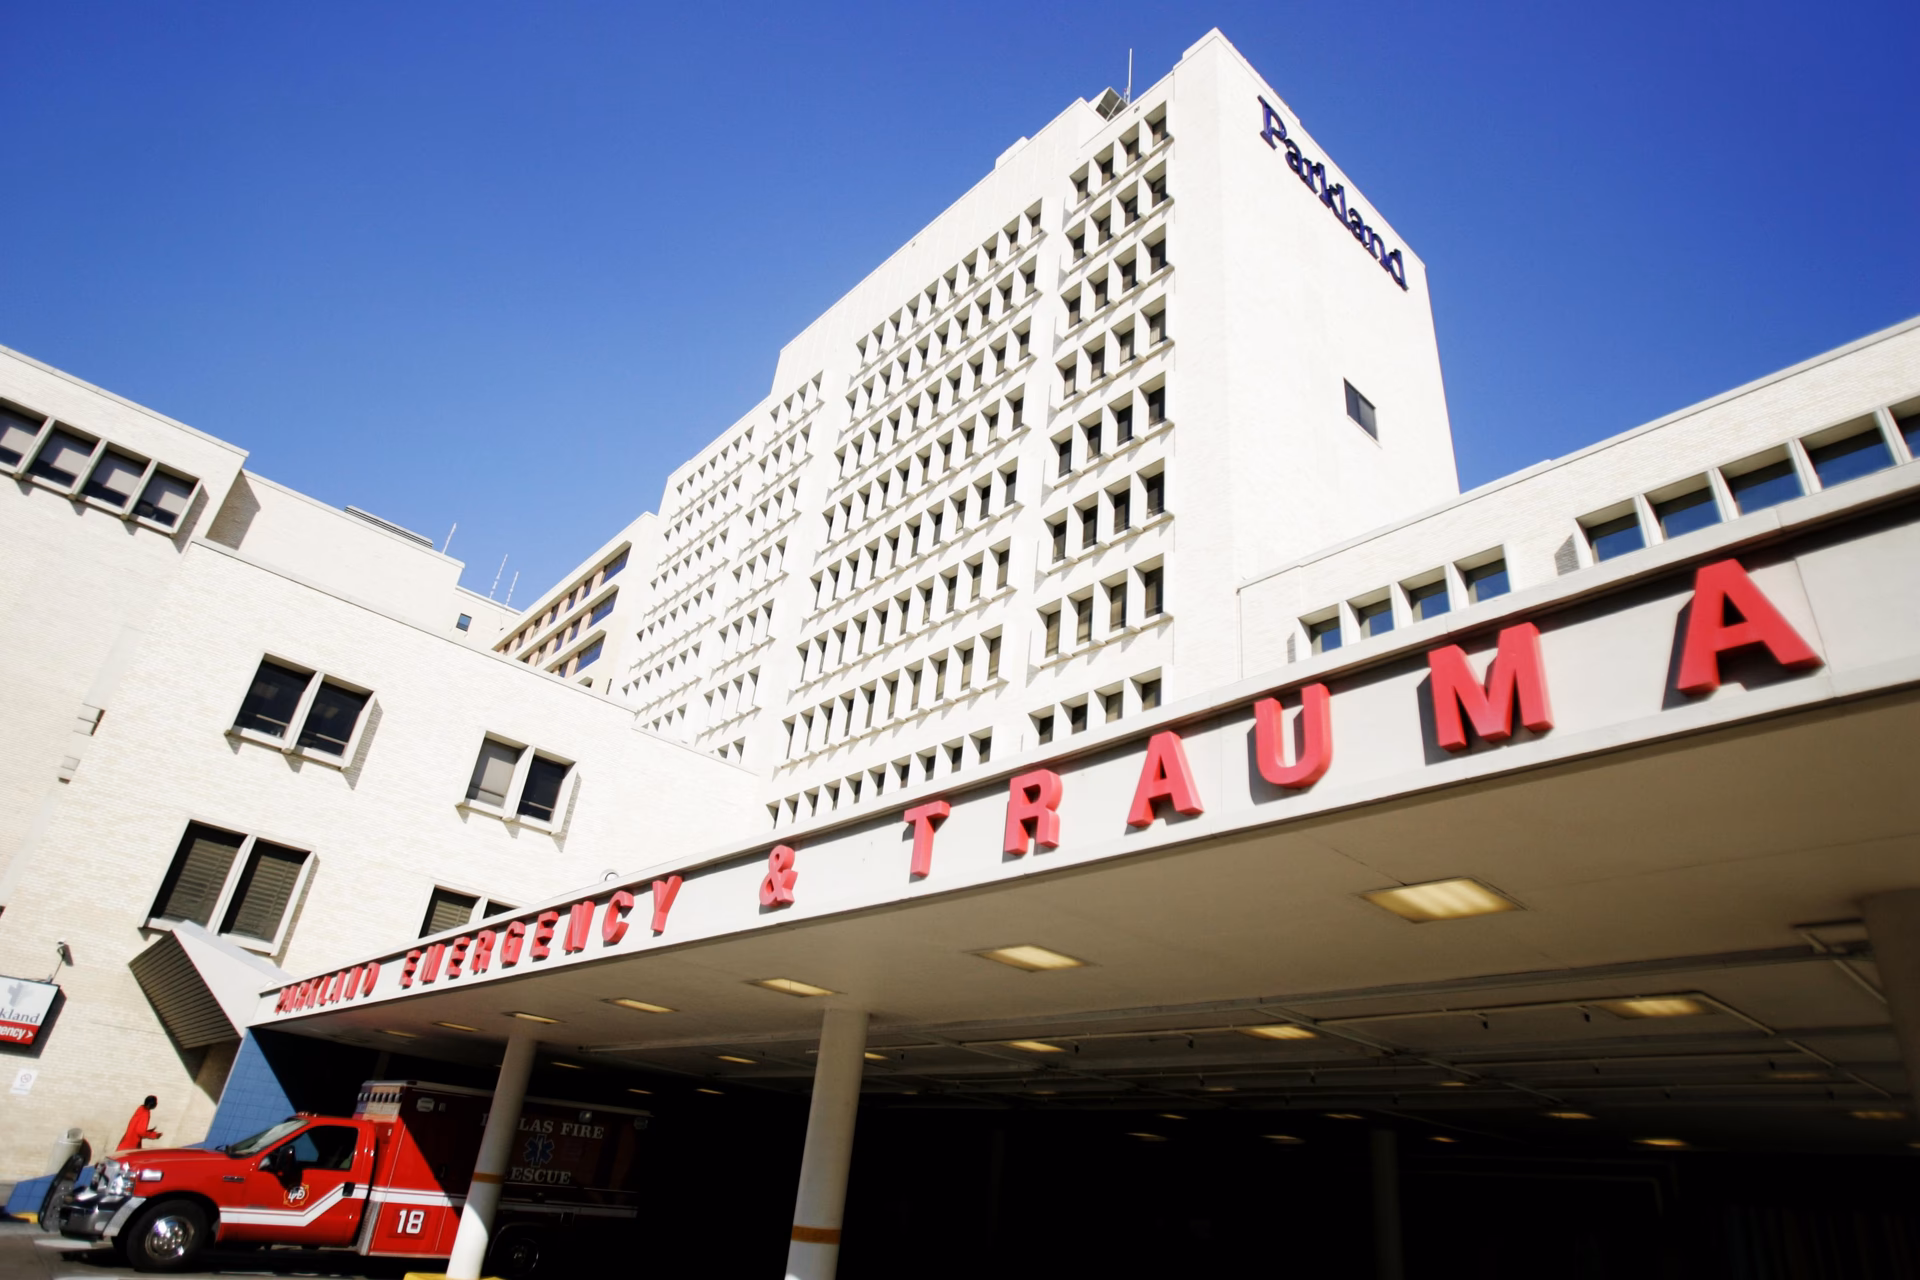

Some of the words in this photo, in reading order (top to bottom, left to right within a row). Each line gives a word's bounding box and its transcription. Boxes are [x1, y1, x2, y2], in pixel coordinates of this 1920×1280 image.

[1257, 94, 1409, 292] Parkland
[274, 962, 381, 1014] PARKLAND
[399, 874, 683, 989] EMERGENCY
[759, 844, 799, 908] &
[903, 557, 1825, 878] TRAUMA
[0, 1025, 27, 1041] ency
[560, 1121, 605, 1140] FIRE
[504, 1166, 572, 1185] ESCUE
[397, 1210, 425, 1235] 18
